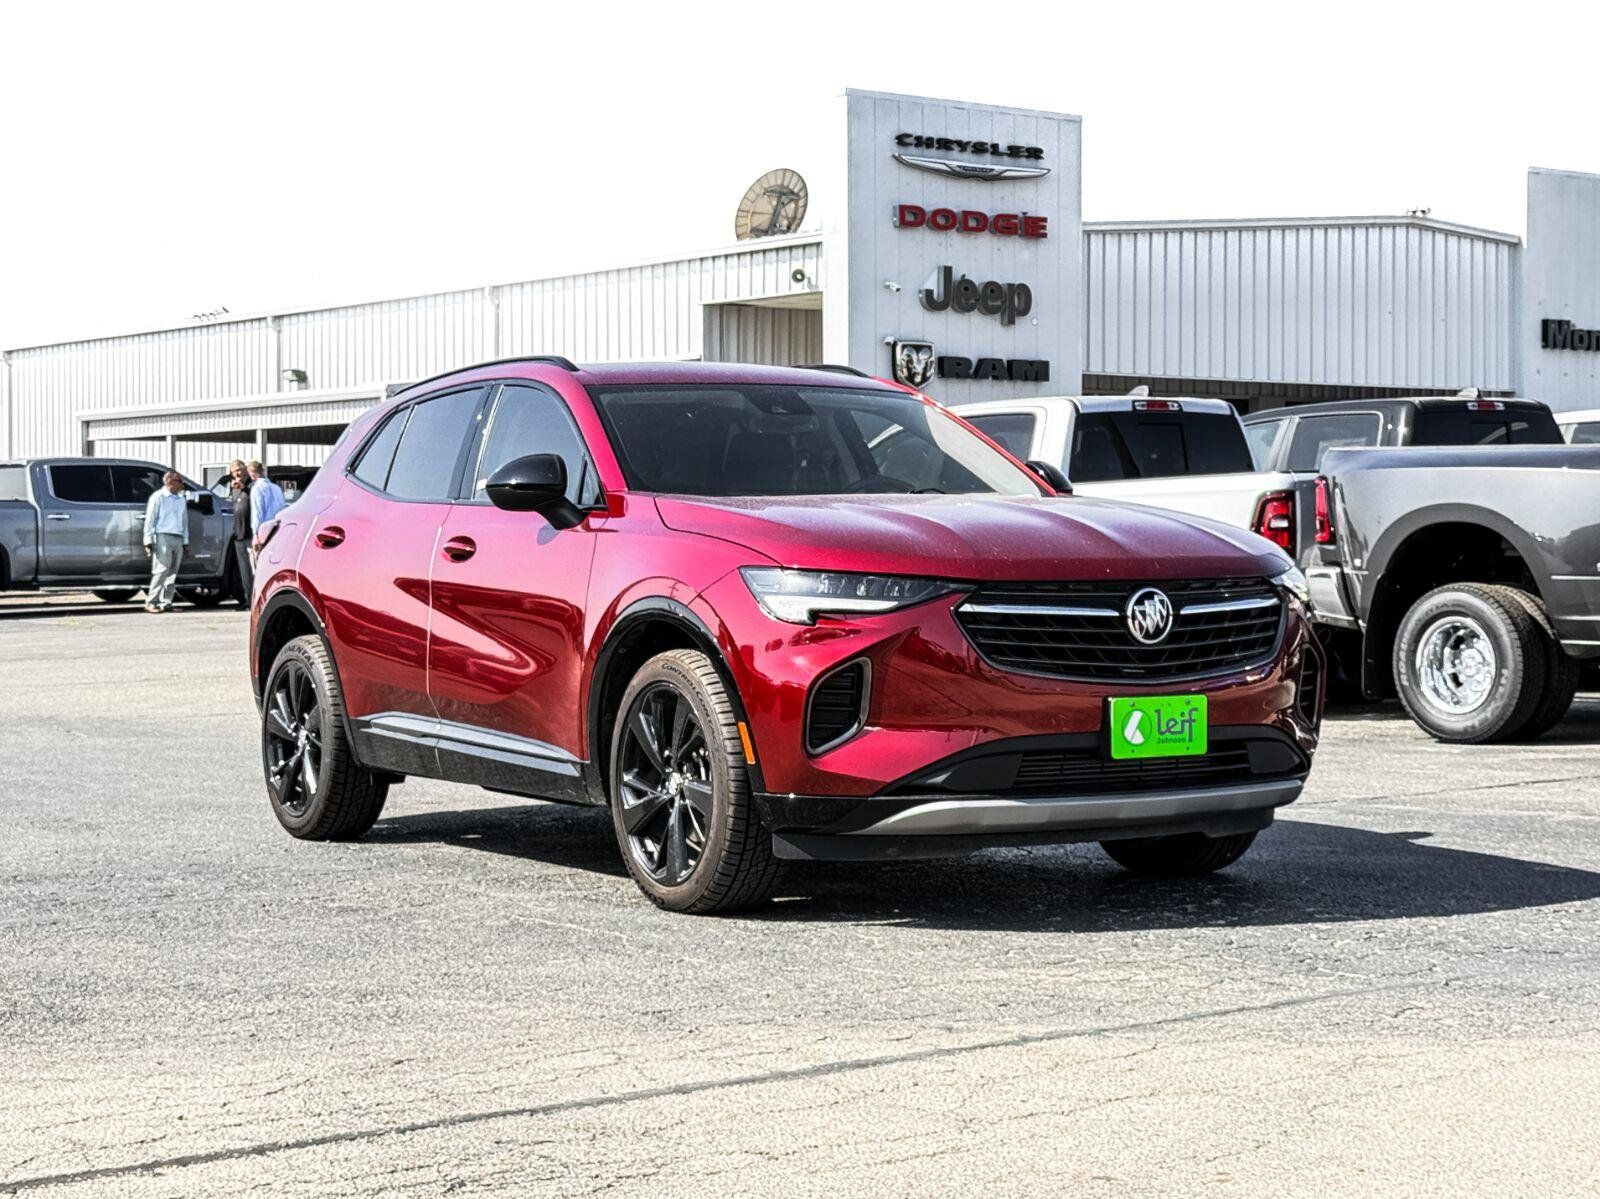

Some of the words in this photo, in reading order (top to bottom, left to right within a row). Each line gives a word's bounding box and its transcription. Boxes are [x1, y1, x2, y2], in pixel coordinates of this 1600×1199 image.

[894, 133, 1045, 160] CHRYSLER
[893, 204, 1048, 239] DODGE
[919, 265, 1032, 326] Jeep
[937, 355, 1050, 382] RAM
